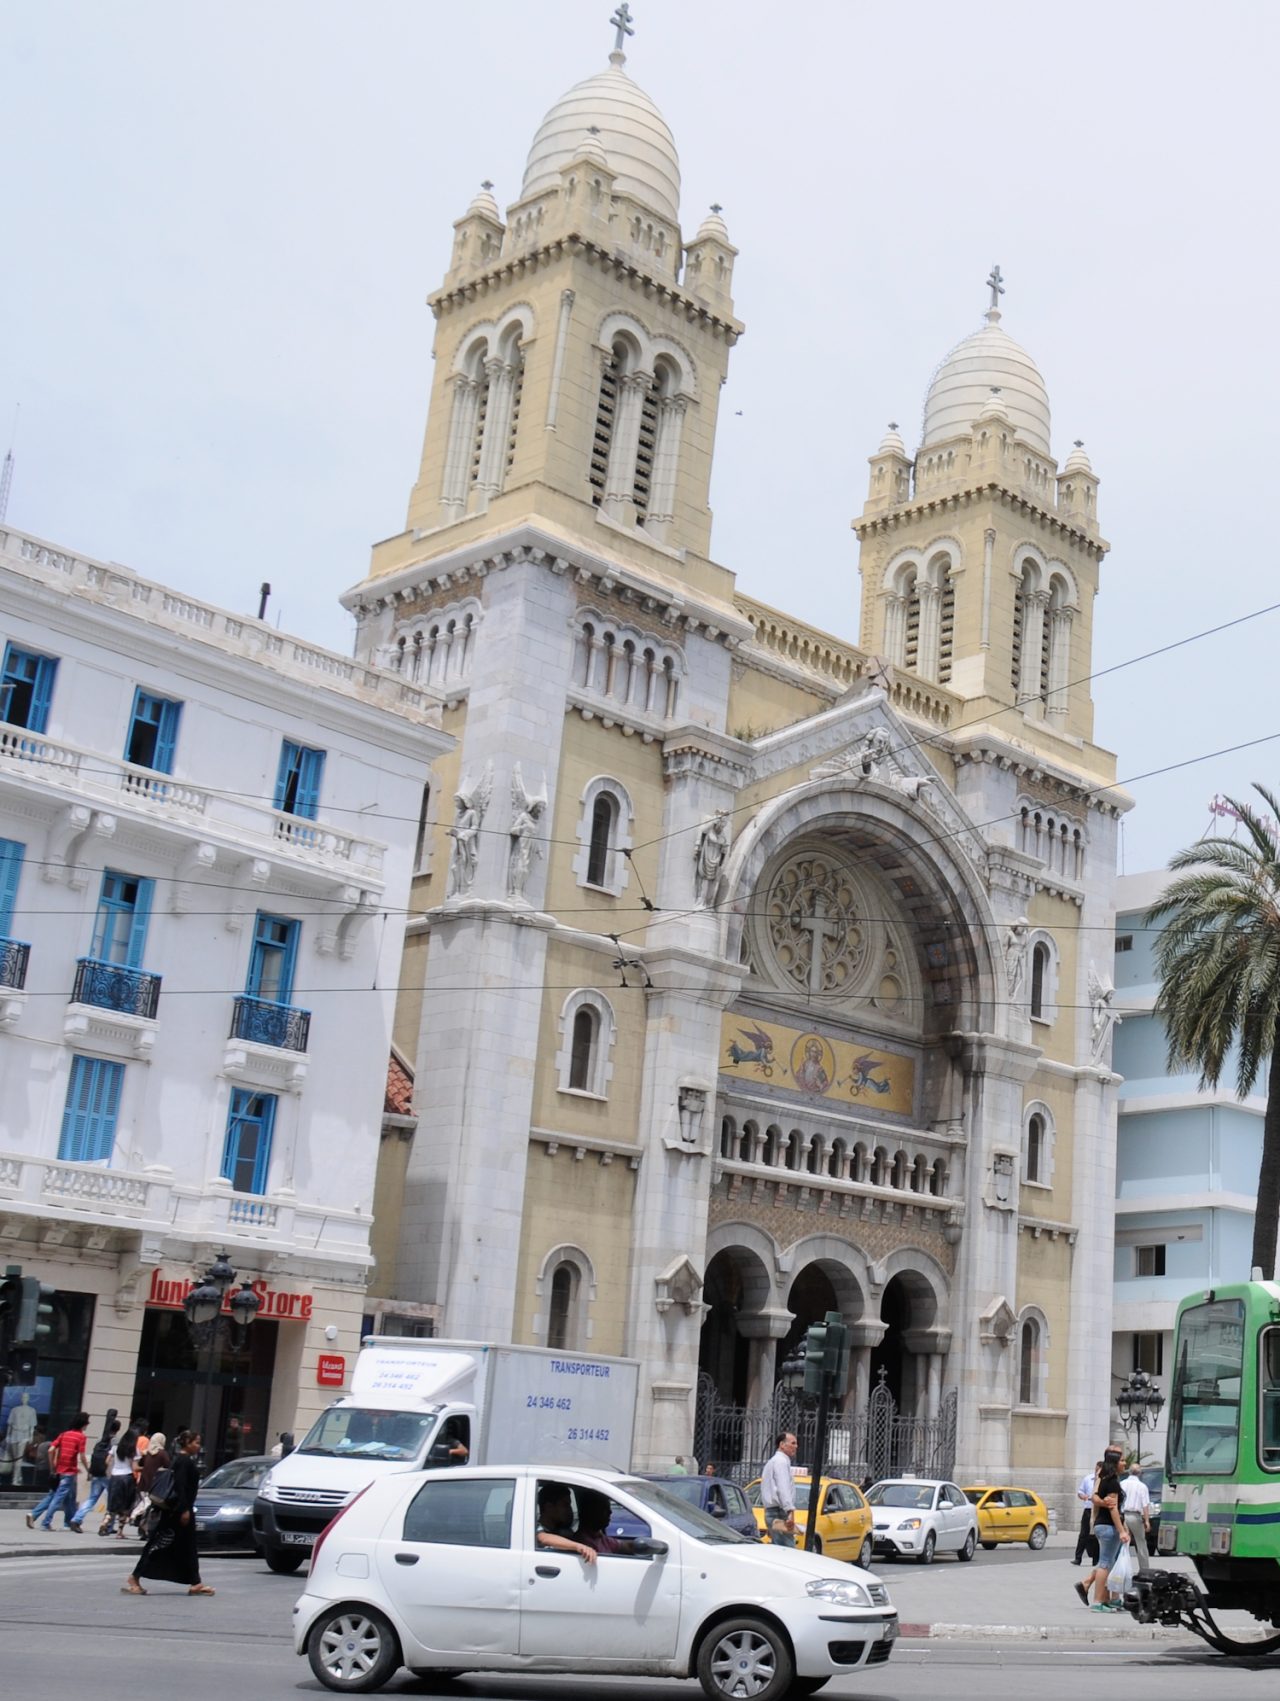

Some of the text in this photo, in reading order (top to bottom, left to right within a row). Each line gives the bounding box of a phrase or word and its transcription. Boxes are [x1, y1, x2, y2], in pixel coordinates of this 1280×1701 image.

[550, 1360, 611, 1378] TRANSPORTEUR
[526, 1395, 572, 1411] 24 346 462
[567, 1428, 610, 1442] 26 314 452
